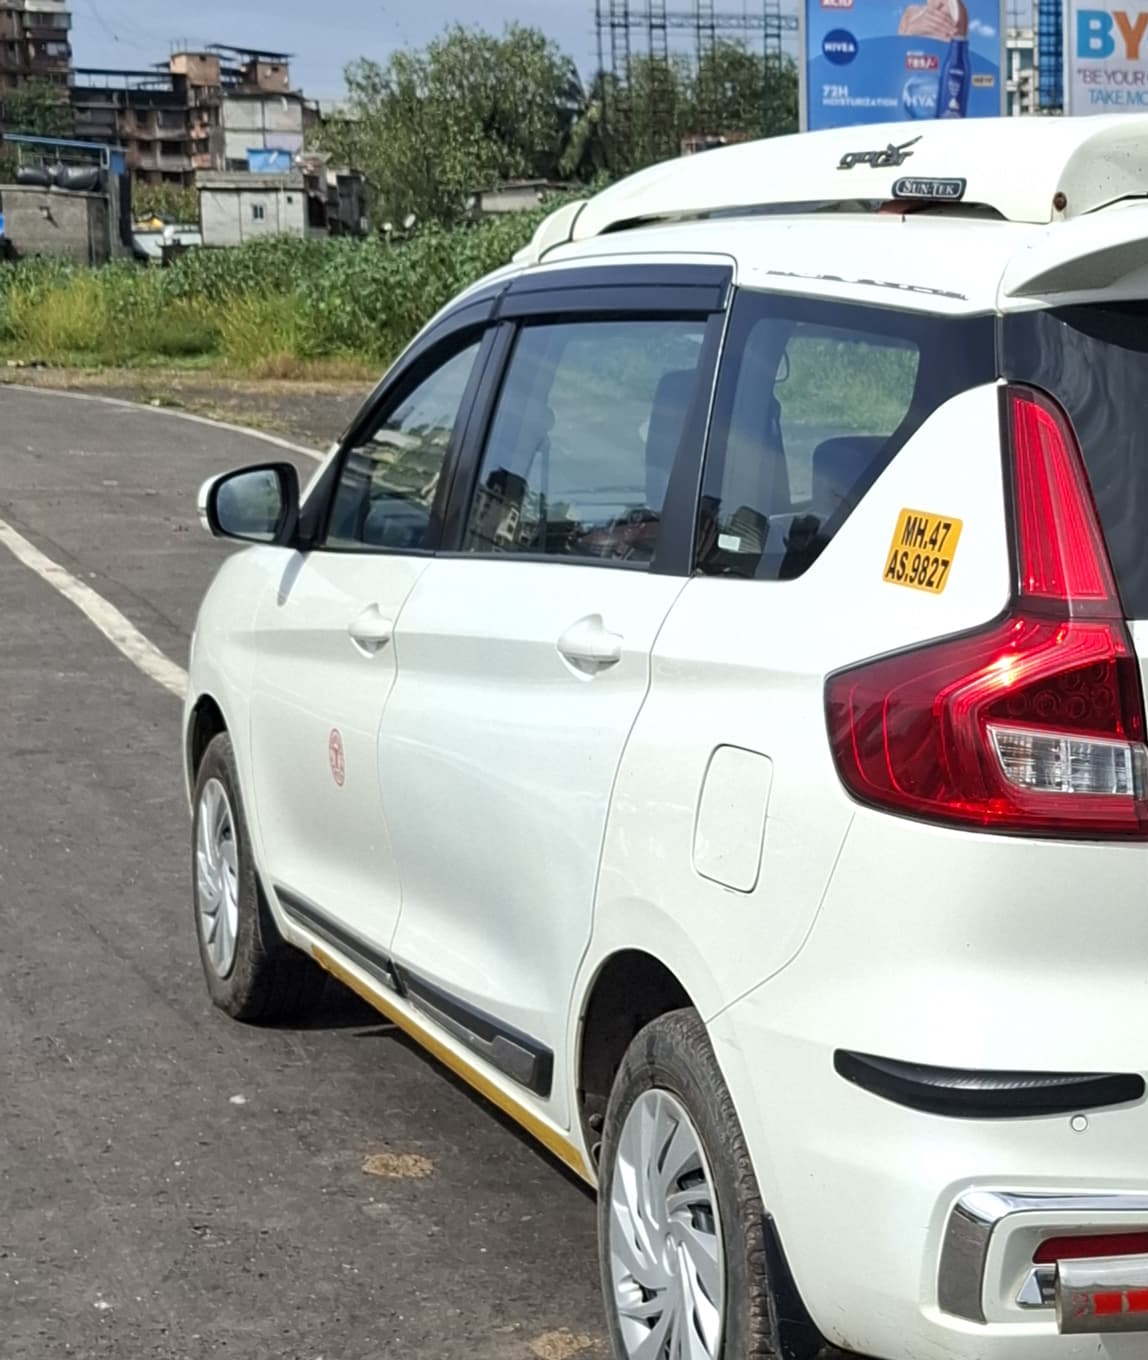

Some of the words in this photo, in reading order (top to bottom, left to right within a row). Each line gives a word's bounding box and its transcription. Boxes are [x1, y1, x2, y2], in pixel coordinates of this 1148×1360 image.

[824, 43, 855, 53] NIVEA
[1104, 70, 1145, 86] YOUR
[822, 85, 849, 97] 72H
[1088, 89, 1123, 105] TAKE
[900, 515, 952, 553] MH.47
[885, 549, 950, 590] AS.9827
